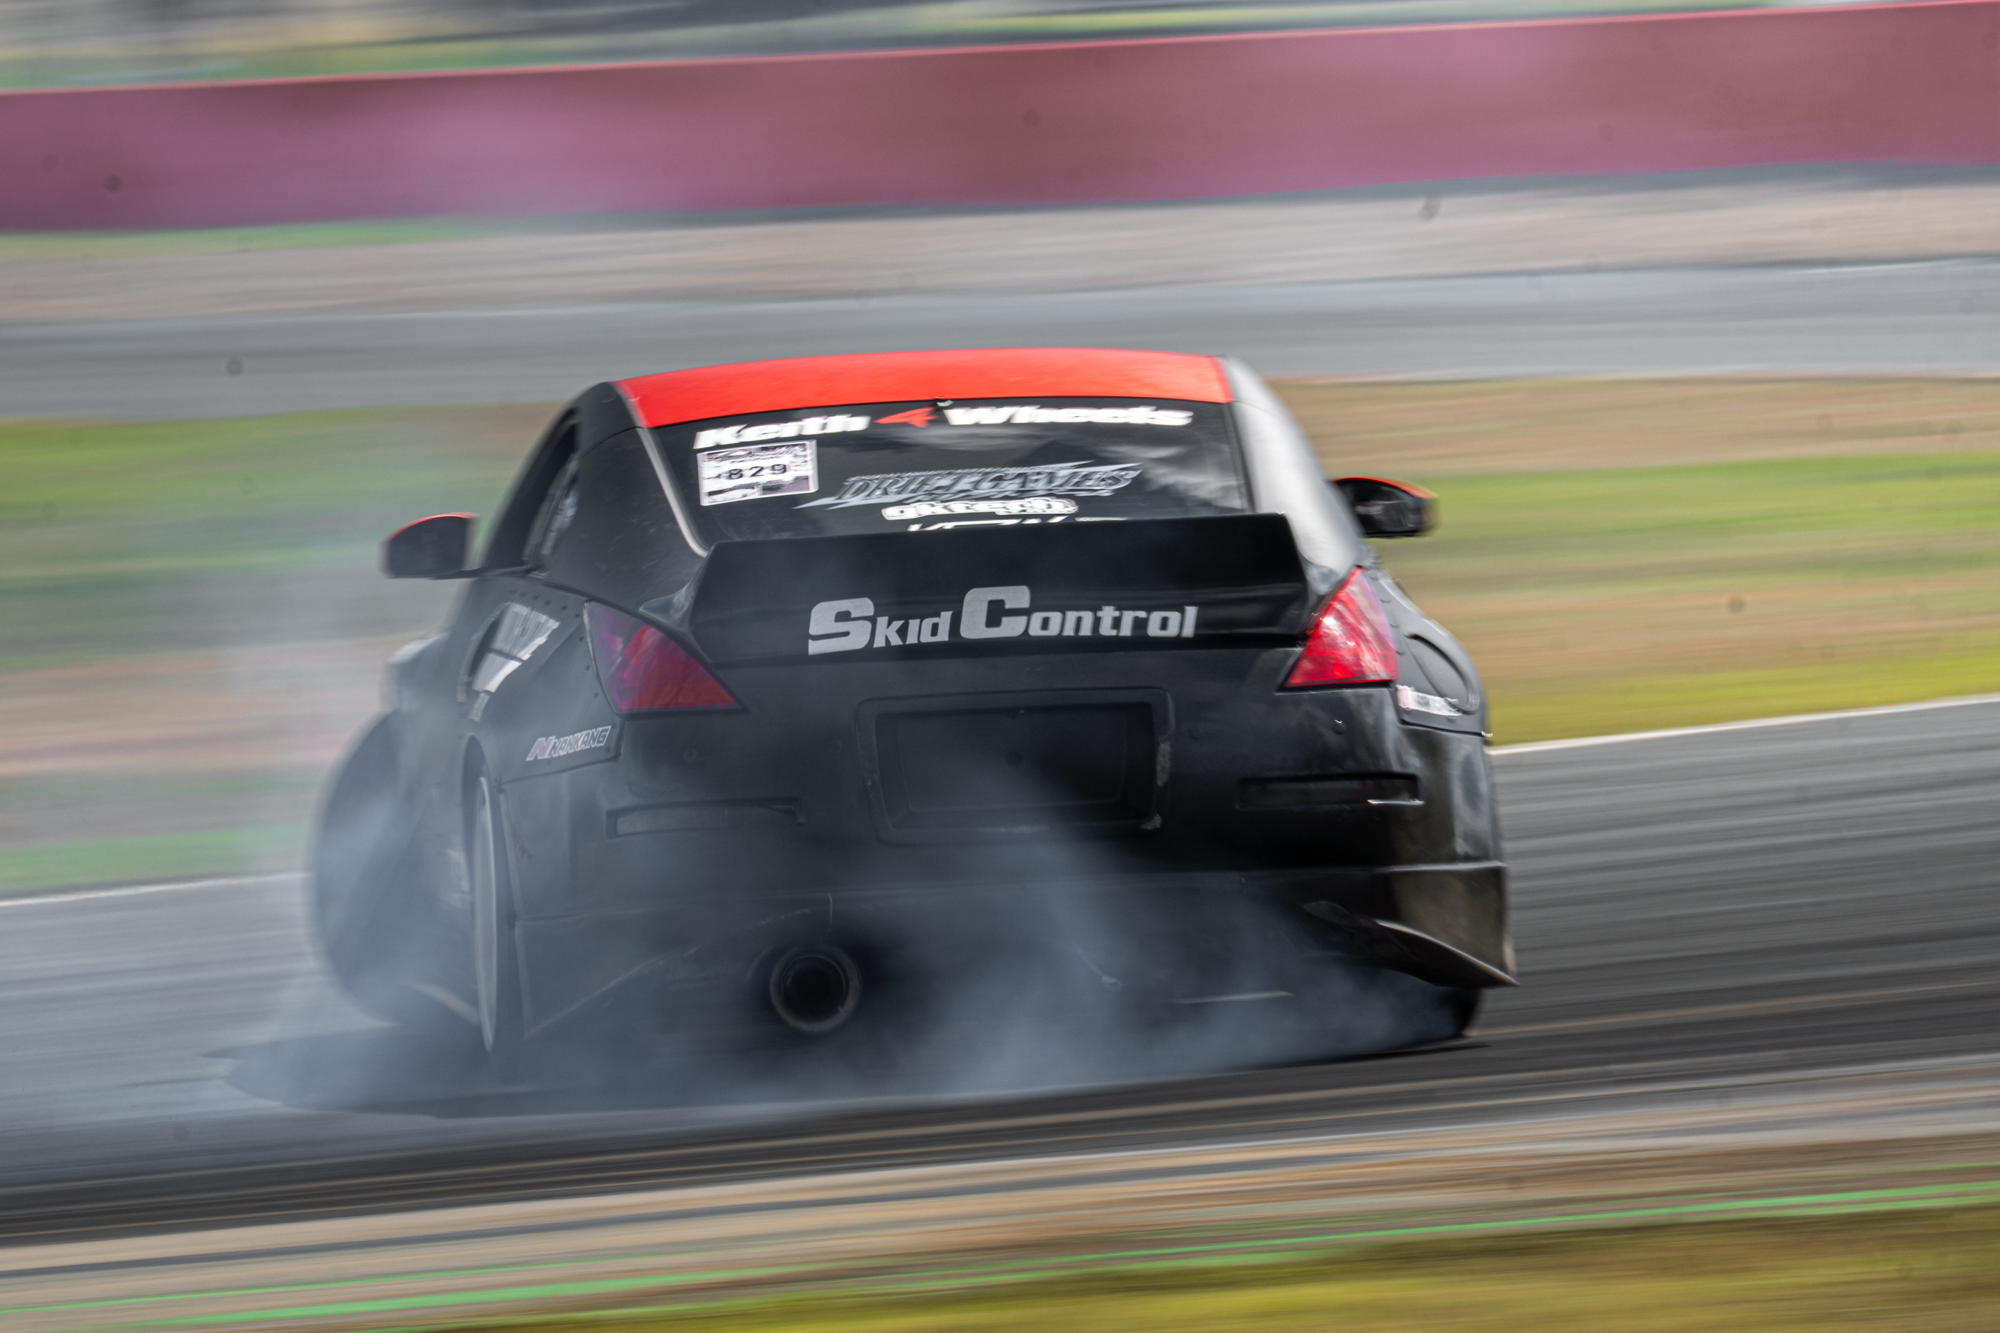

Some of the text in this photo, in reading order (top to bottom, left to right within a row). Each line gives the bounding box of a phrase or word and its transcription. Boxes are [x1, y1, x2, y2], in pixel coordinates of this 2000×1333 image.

[693, 405, 1194, 449] Keith Wheels
[728, 464, 787, 480] 829
[808, 585, 1198, 655] Skid Control
[550, 725, 611, 757] NANKANG
